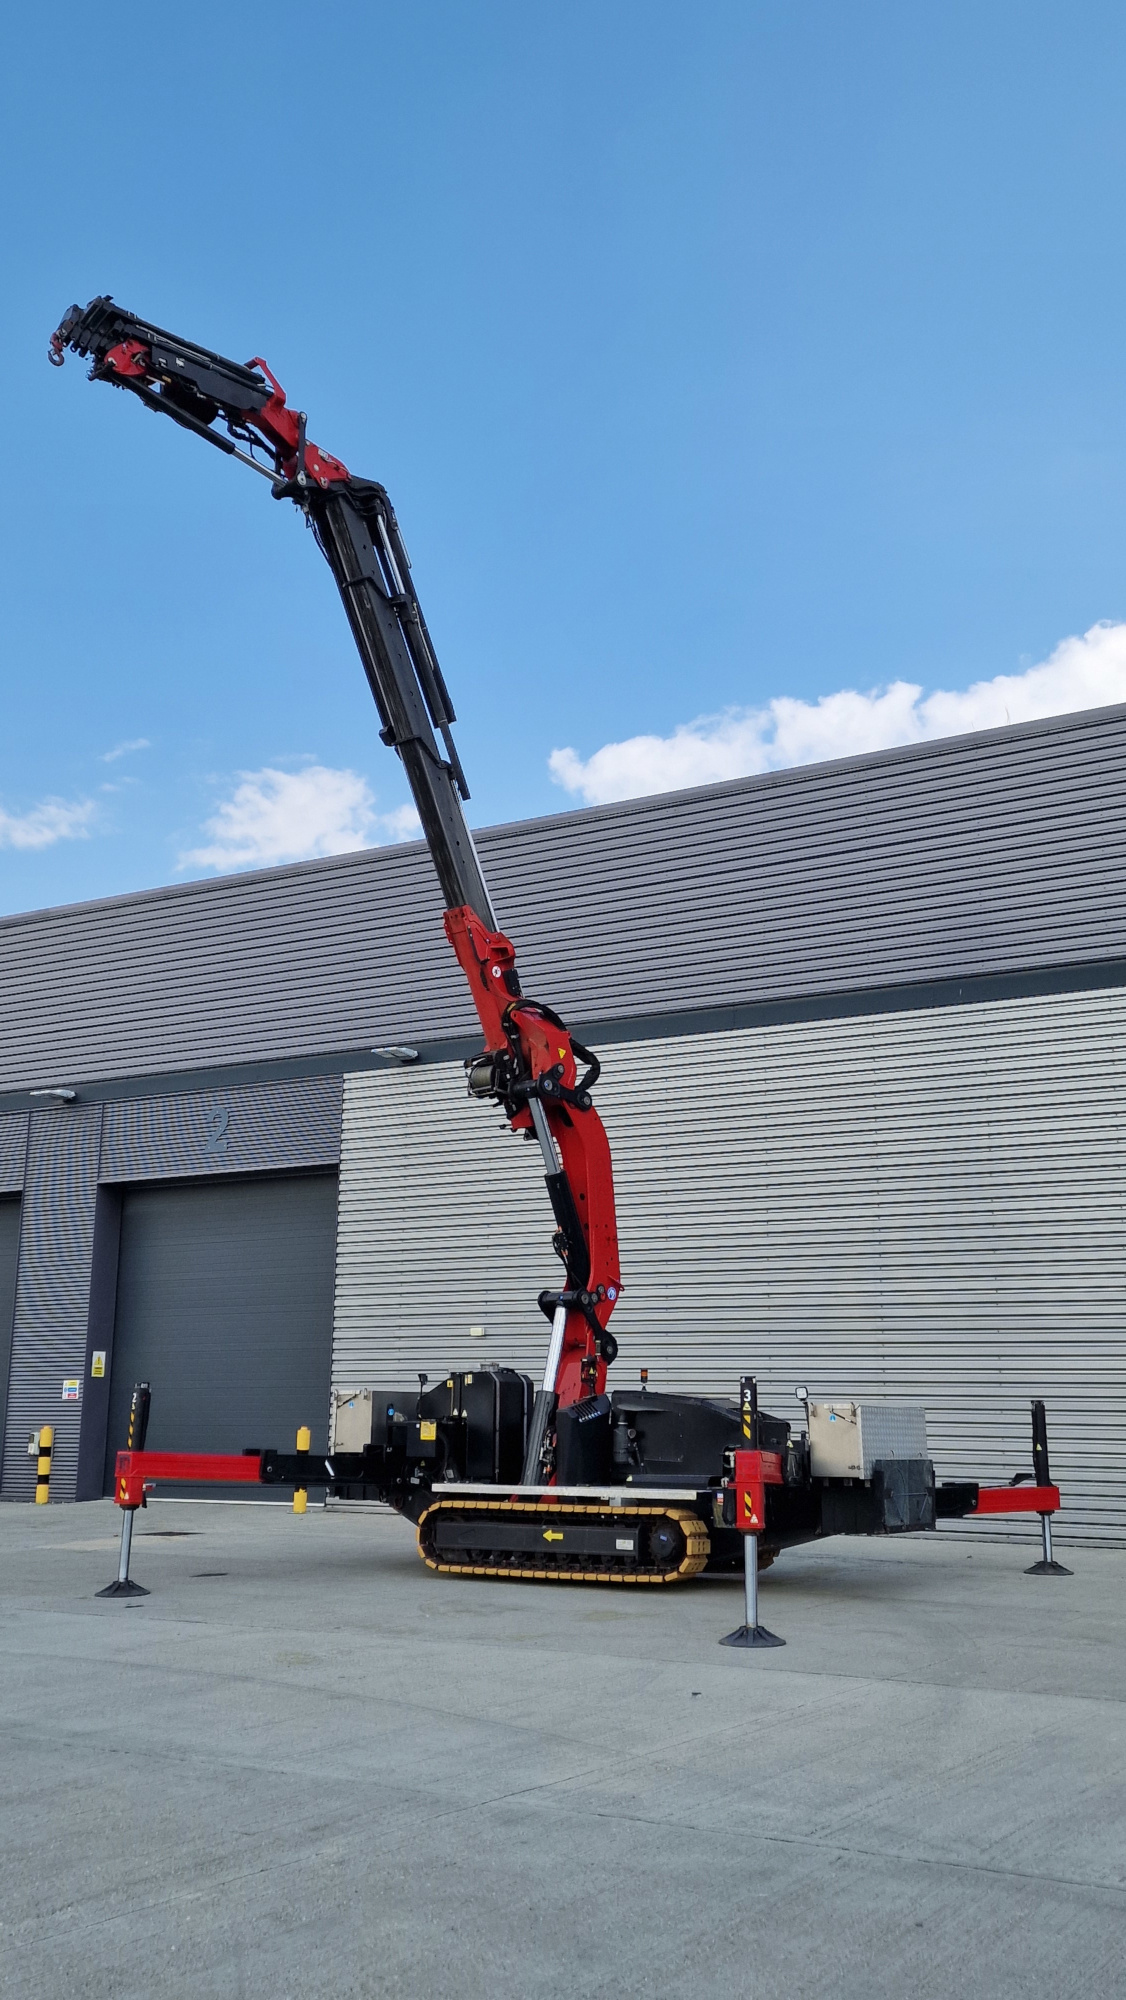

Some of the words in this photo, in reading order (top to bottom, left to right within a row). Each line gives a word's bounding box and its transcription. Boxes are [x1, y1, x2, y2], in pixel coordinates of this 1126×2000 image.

[204, 1106, 229, 1153] 2
[132, 1392, 137, 1403] 2
[743, 1389, 751, 1402] 3
